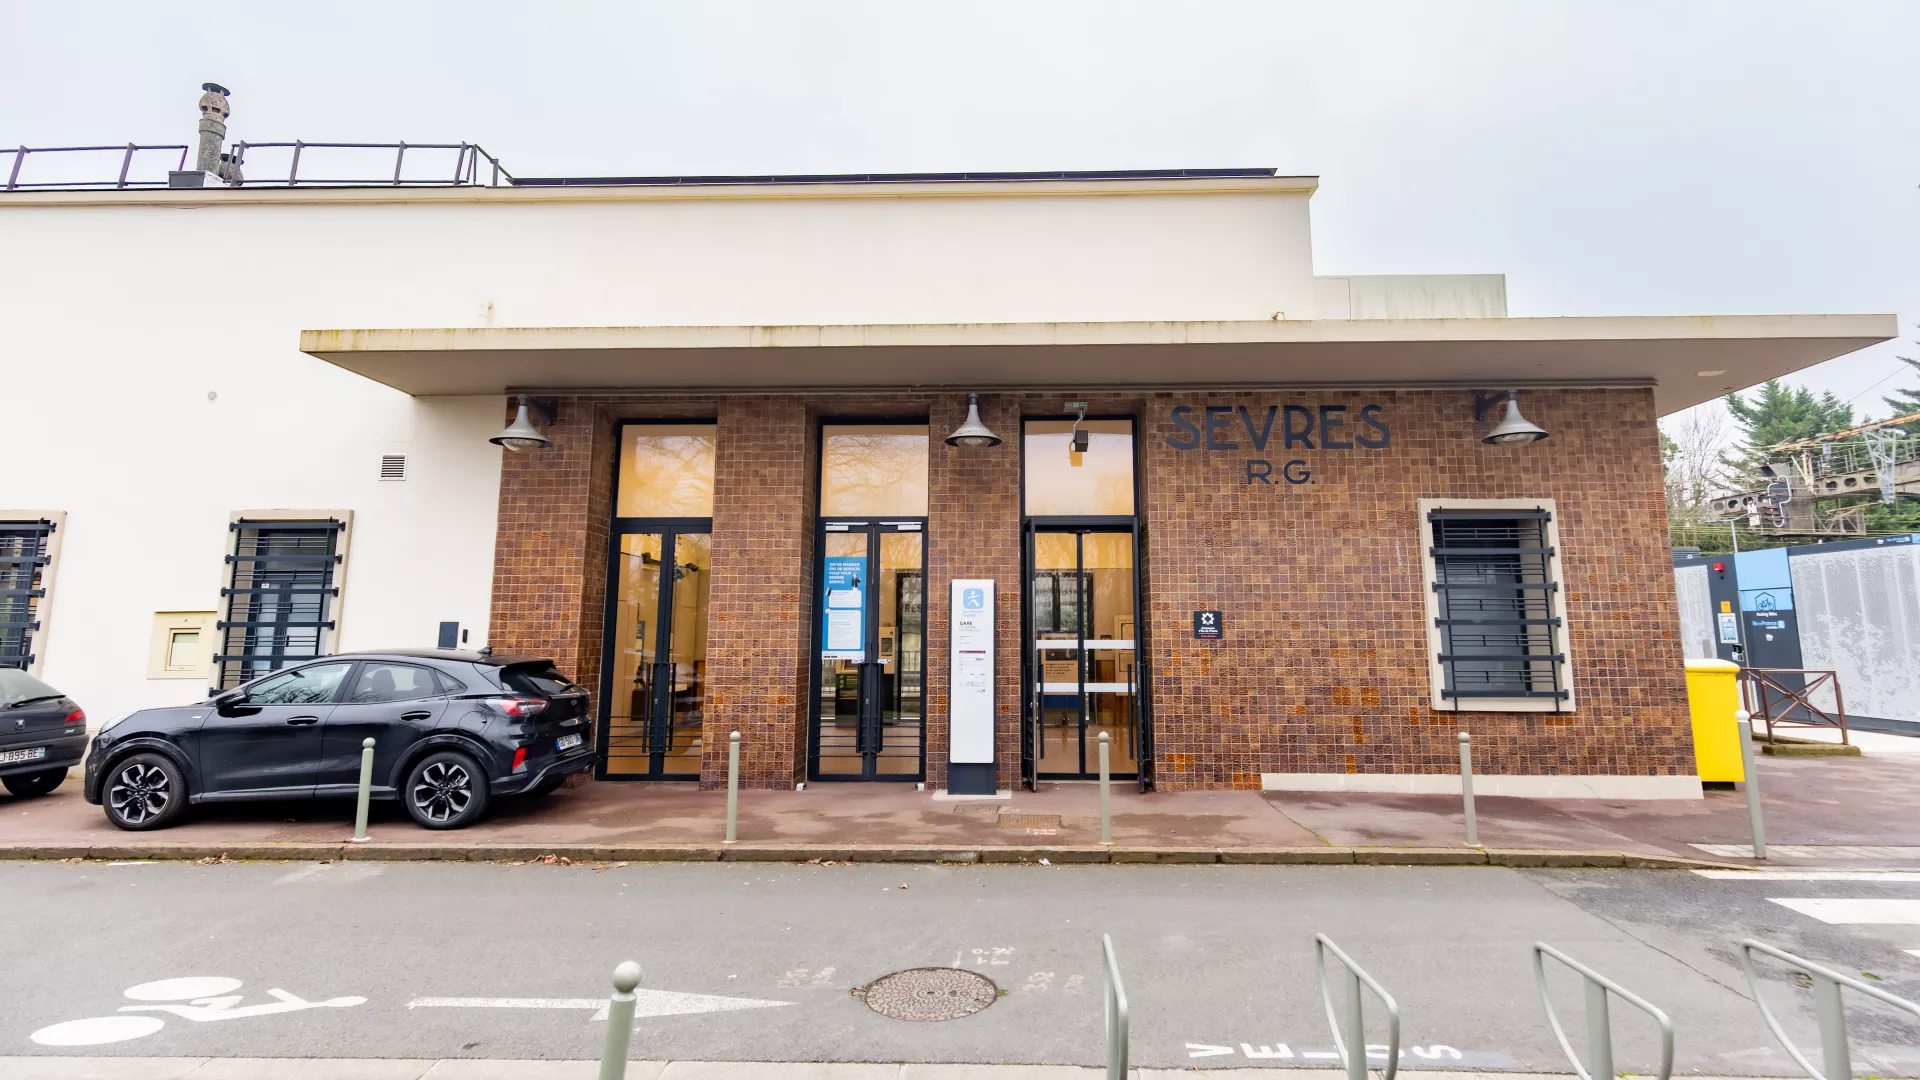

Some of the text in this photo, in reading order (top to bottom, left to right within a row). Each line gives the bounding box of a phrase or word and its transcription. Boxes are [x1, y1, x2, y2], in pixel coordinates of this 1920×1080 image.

[1165, 404, 1391, 450] SEVRES
[1247, 459, 1315, 485] R.G.
[902, 603, 922, 613] RES
